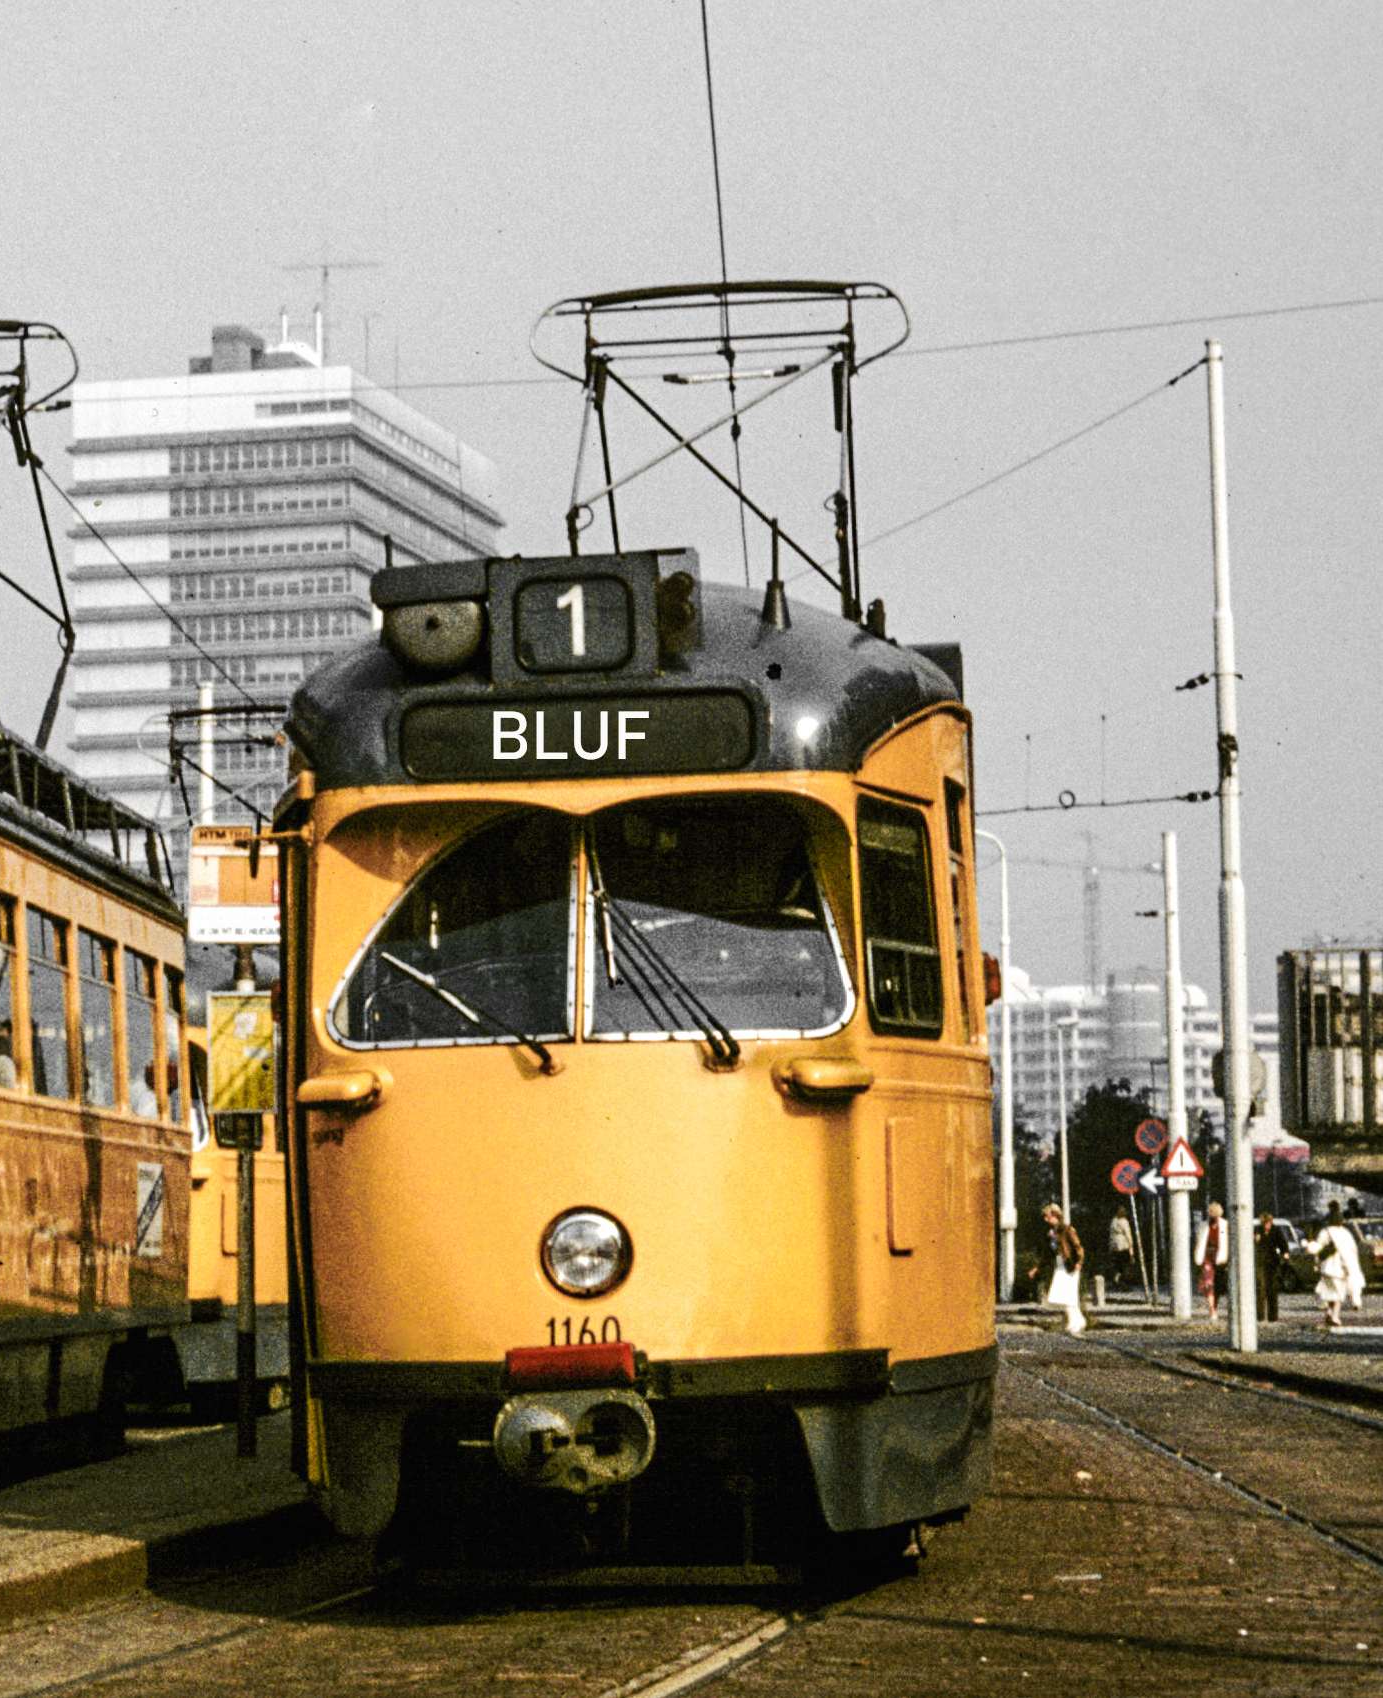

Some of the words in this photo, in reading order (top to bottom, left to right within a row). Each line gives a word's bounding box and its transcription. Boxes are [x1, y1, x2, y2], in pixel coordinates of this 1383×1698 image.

[556, 583, 586, 657] 1
[492, 710, 650, 760] BLUF
[546, 1315, 621, 1346] 1160
